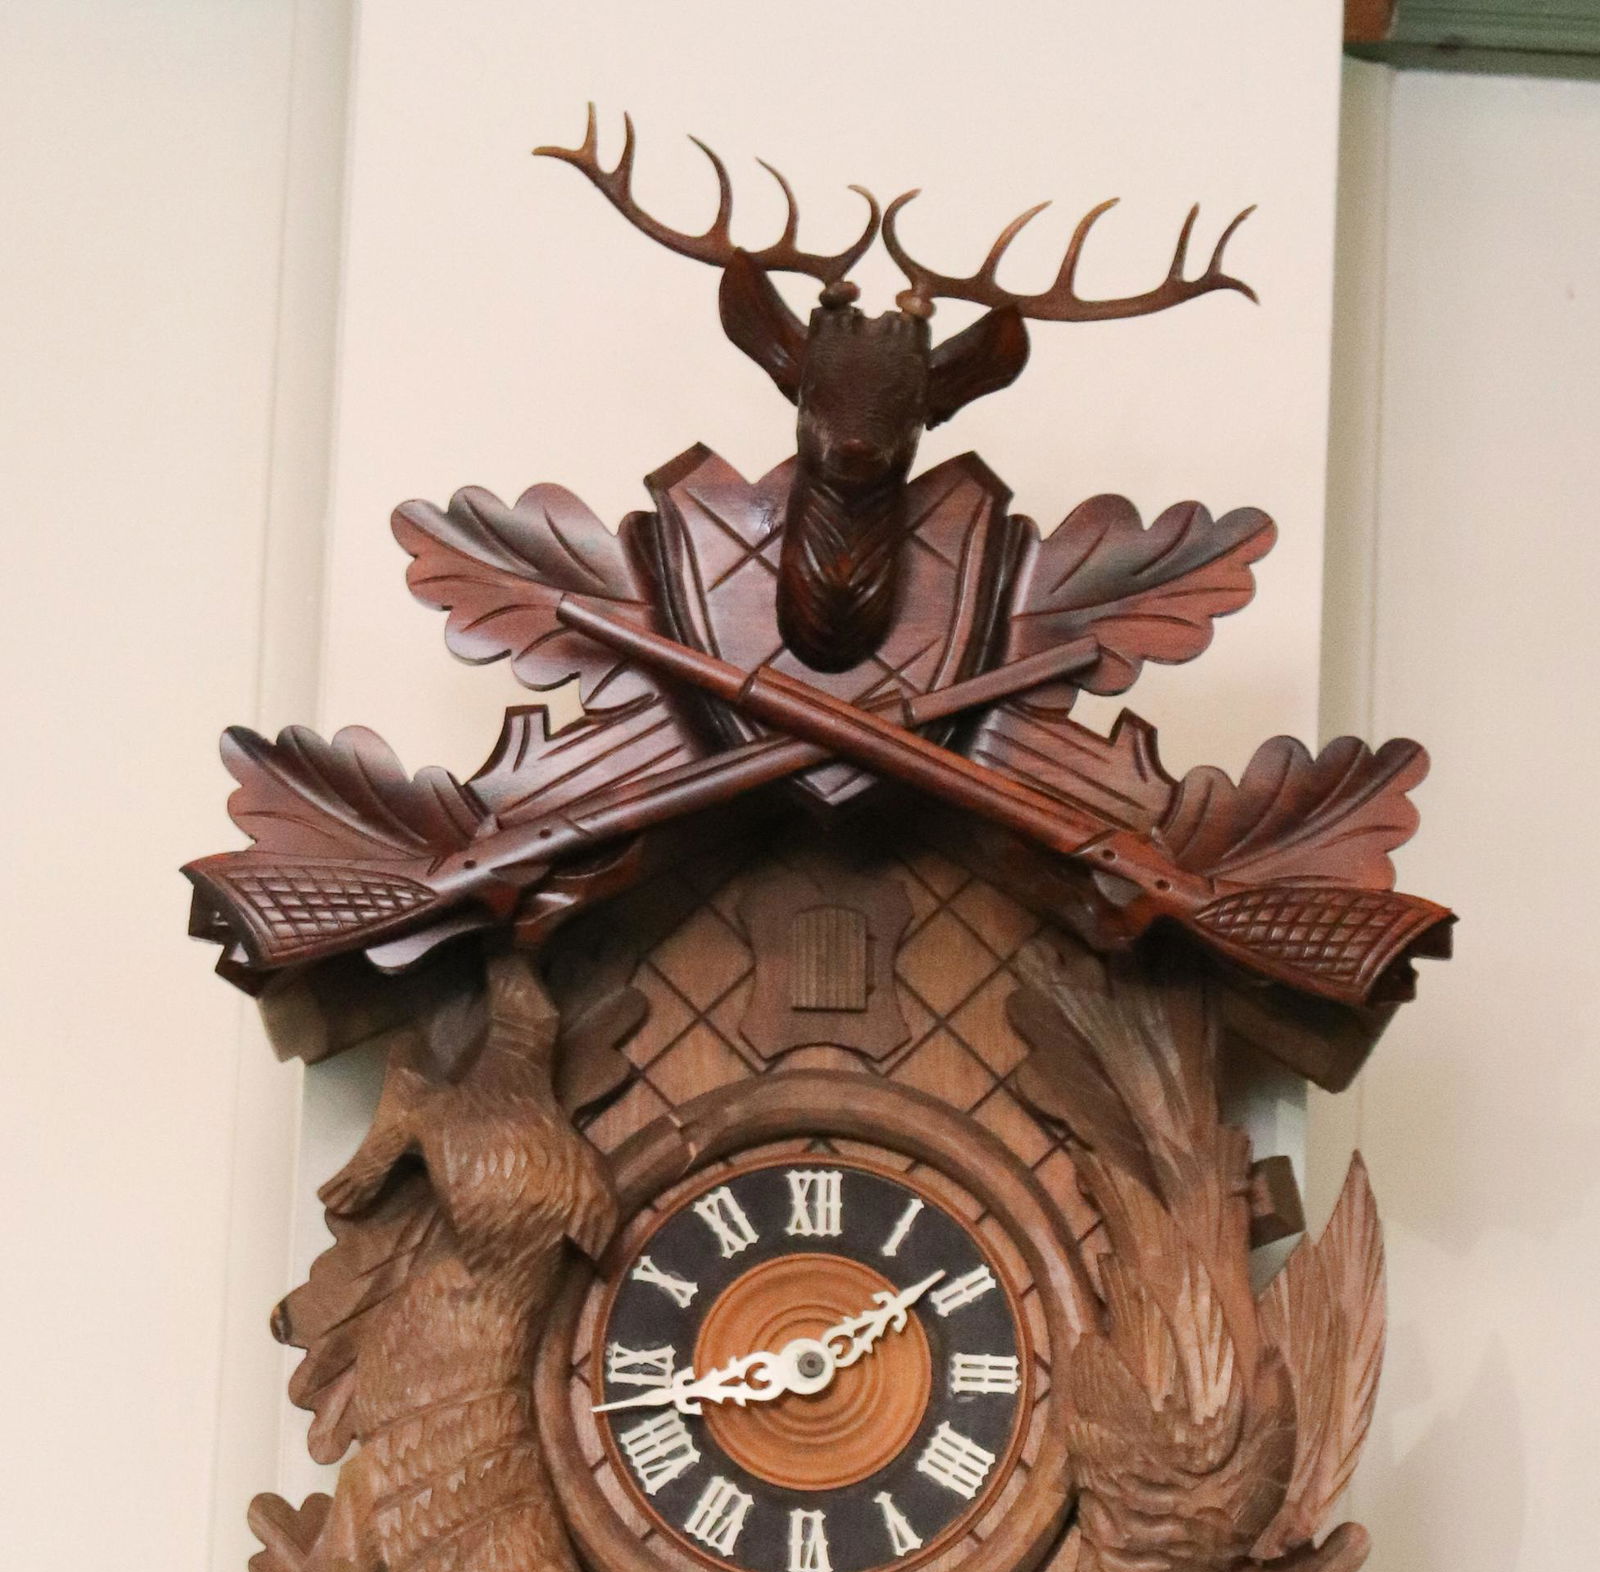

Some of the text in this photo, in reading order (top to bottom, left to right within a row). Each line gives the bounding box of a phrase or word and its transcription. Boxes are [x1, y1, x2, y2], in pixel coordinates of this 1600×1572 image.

[693, 1186, 759, 1258] XI
[785, 1169, 843, 1237] XII
[881, 1199, 924, 1256] I
[633, 1255, 699, 1309] X
[930, 1265, 996, 1317] II
[607, 1341, 677, 1388] IX
[951, 1352, 1020, 1394] III
[620, 1408, 701, 1496] VIII
[917, 1421, 996, 1500] IIII
[684, 1476, 754, 1557] VII
[875, 1491, 923, 1556] V
